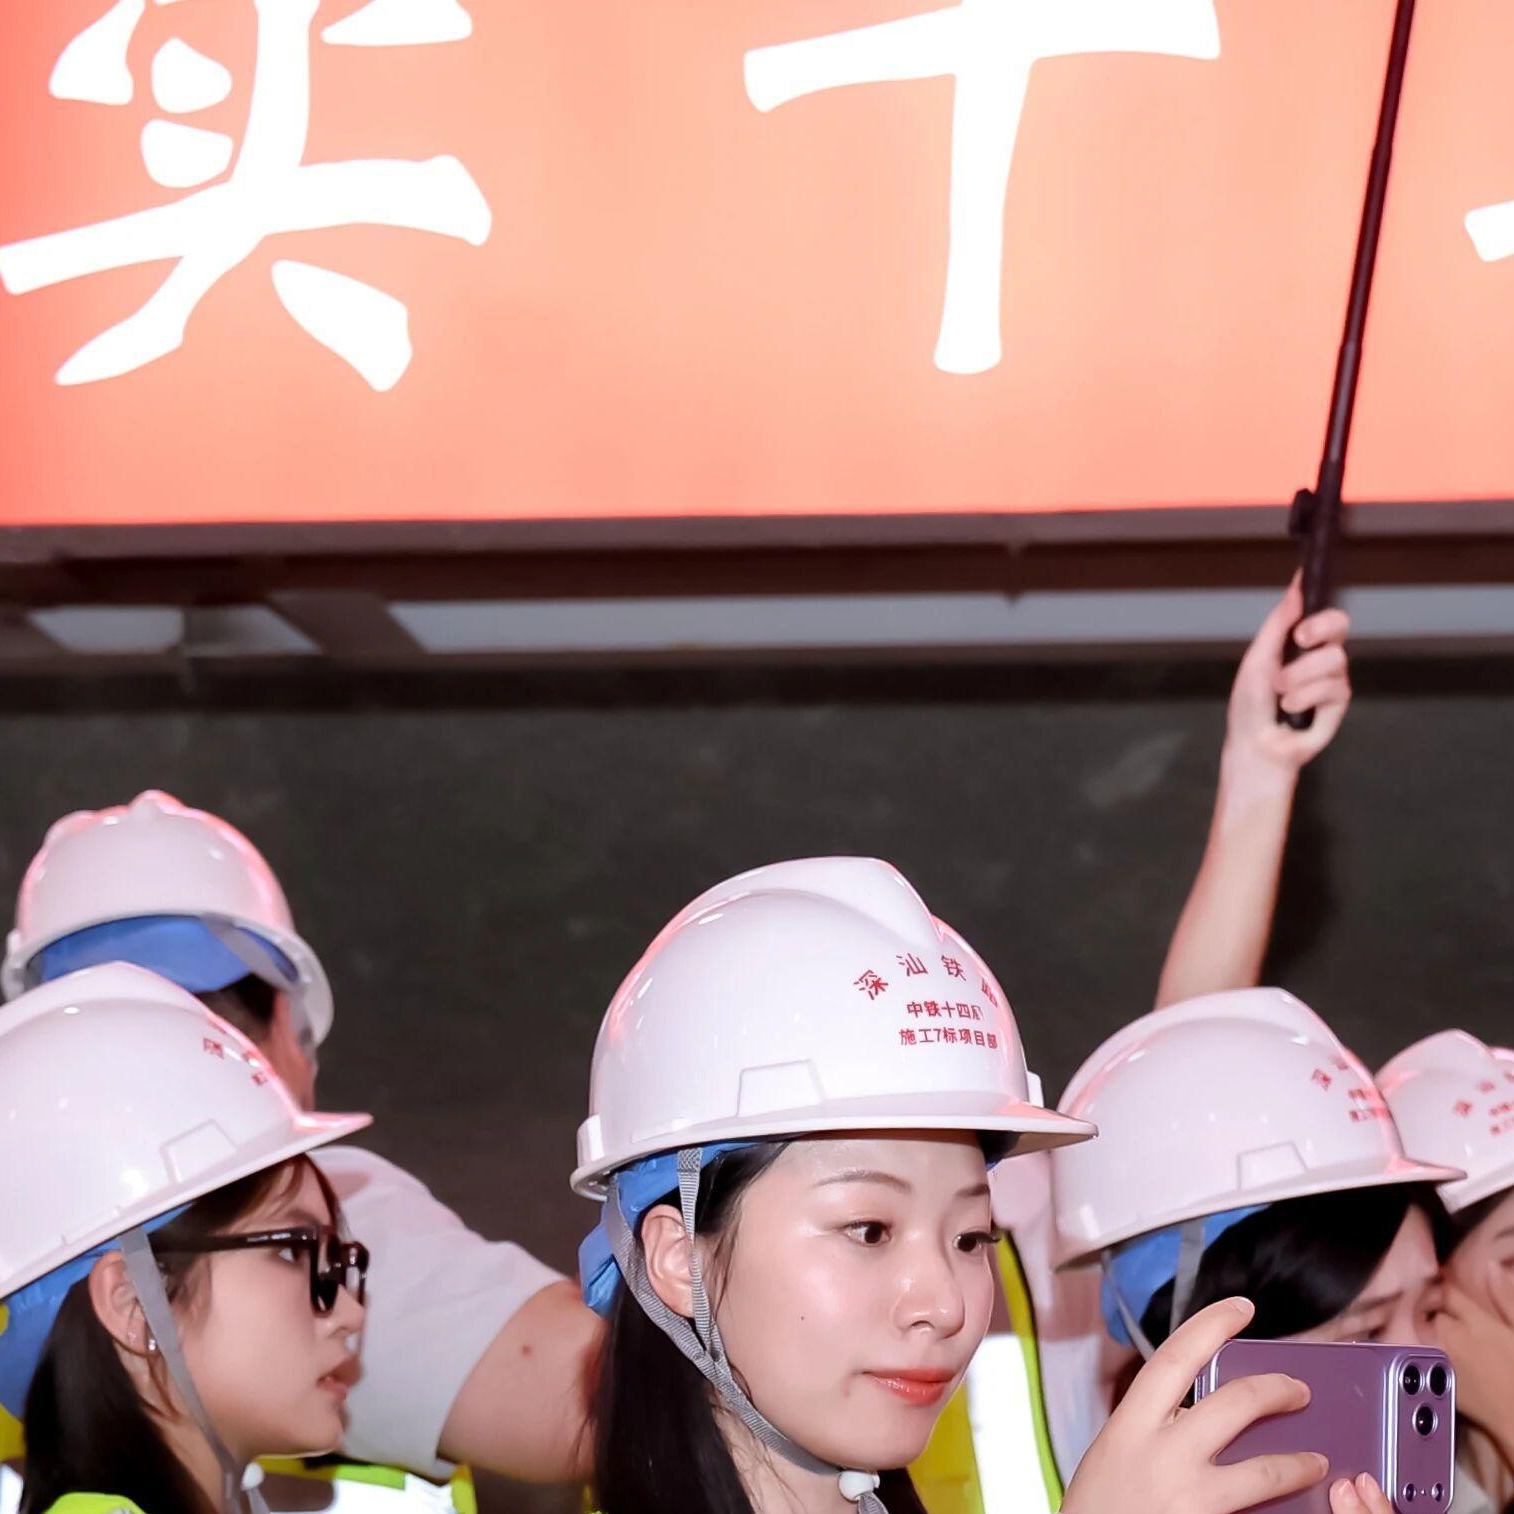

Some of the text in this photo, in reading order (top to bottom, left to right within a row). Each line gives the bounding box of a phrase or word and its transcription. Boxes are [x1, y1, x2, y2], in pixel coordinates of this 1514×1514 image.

[906, 1001, 984, 1021] 中铁十四局
[899, 1027, 998, 1050] 施工7标项目部
